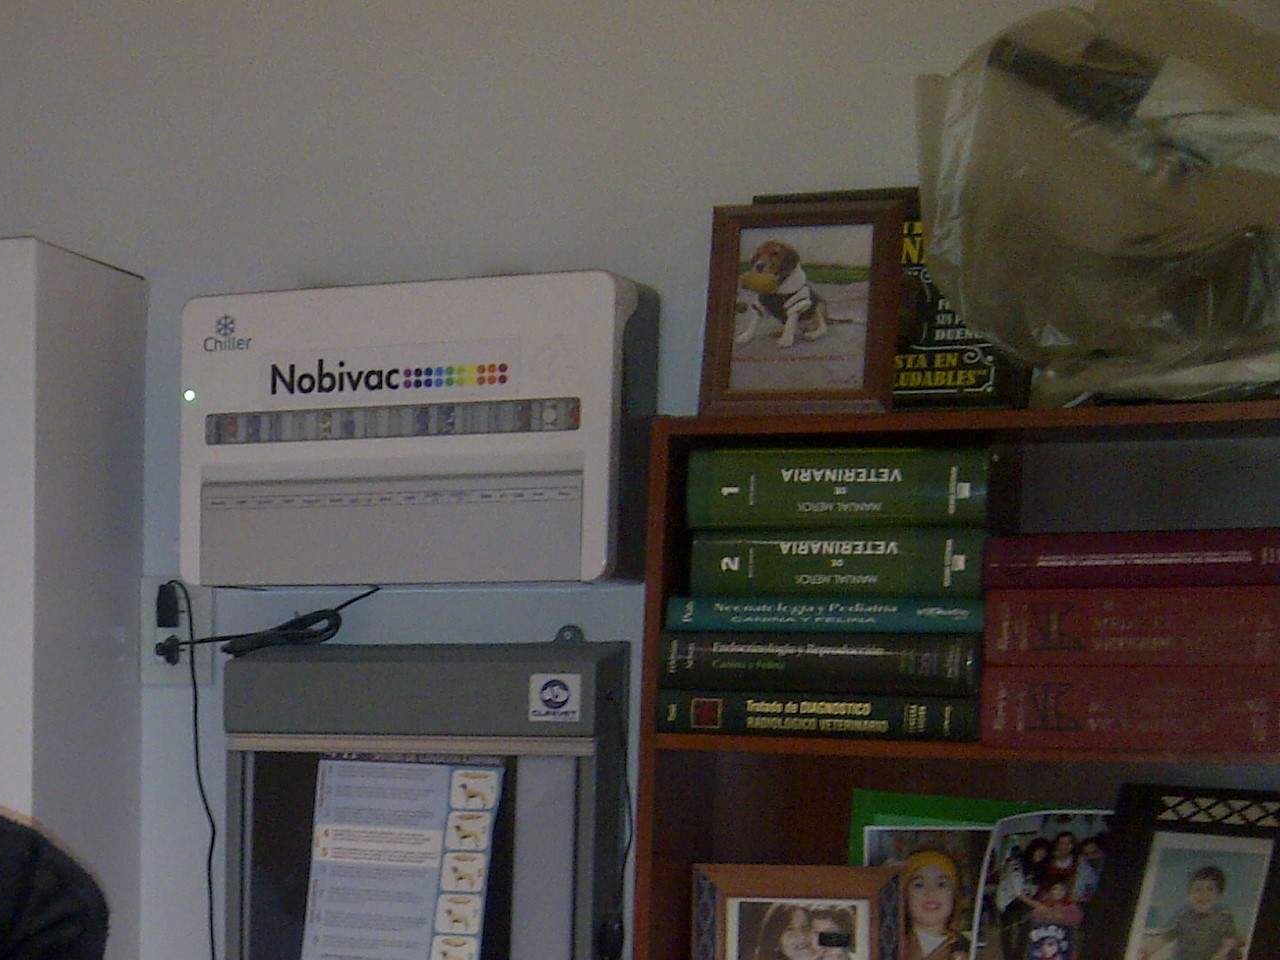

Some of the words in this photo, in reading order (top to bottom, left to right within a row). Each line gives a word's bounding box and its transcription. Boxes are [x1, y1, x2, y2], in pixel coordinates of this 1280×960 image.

[203, 337, 252, 352] Chiller
[271, 359, 400, 395] Nobivac
[780, 468, 903, 482] VETERINARIA
[779, 541, 899, 555] VETERINARIA
